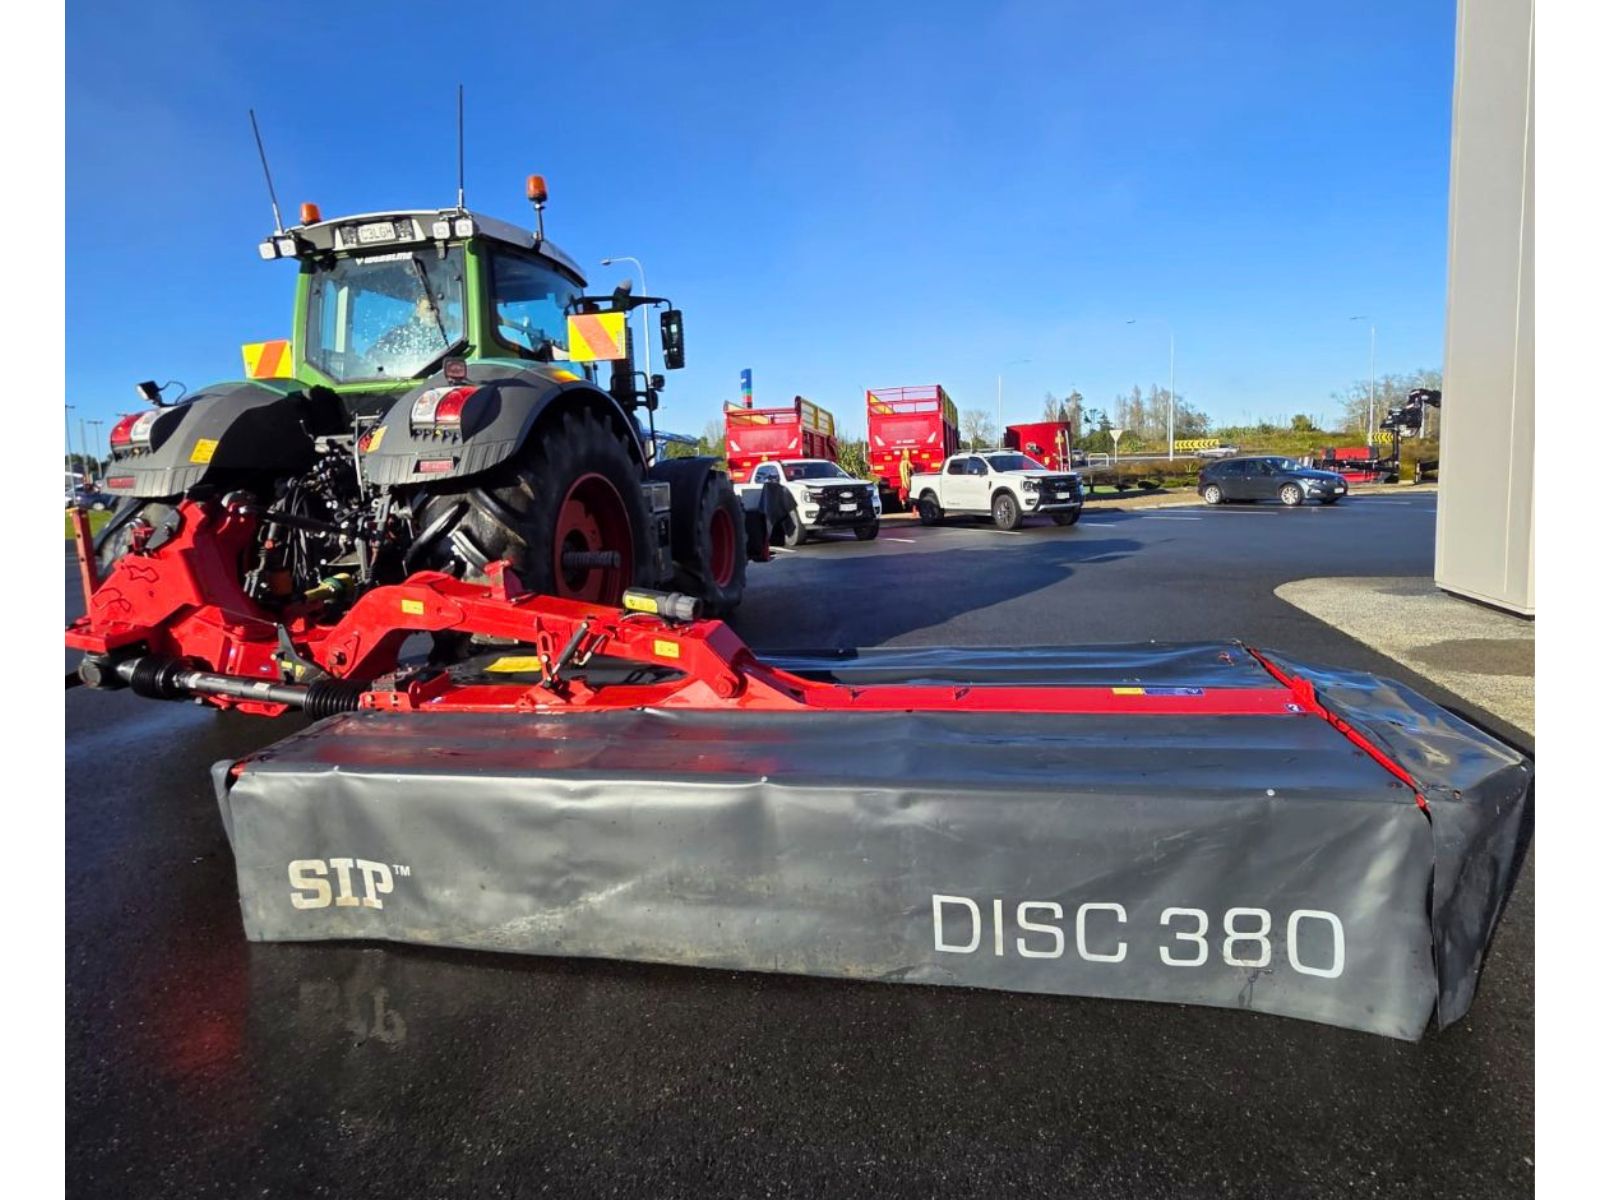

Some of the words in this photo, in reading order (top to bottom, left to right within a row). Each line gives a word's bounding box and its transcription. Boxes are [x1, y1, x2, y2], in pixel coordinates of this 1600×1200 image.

[288, 858, 394, 909] SIP
[932, 894, 1128, 963] DISC
[1159, 907, 1346, 979] 380
